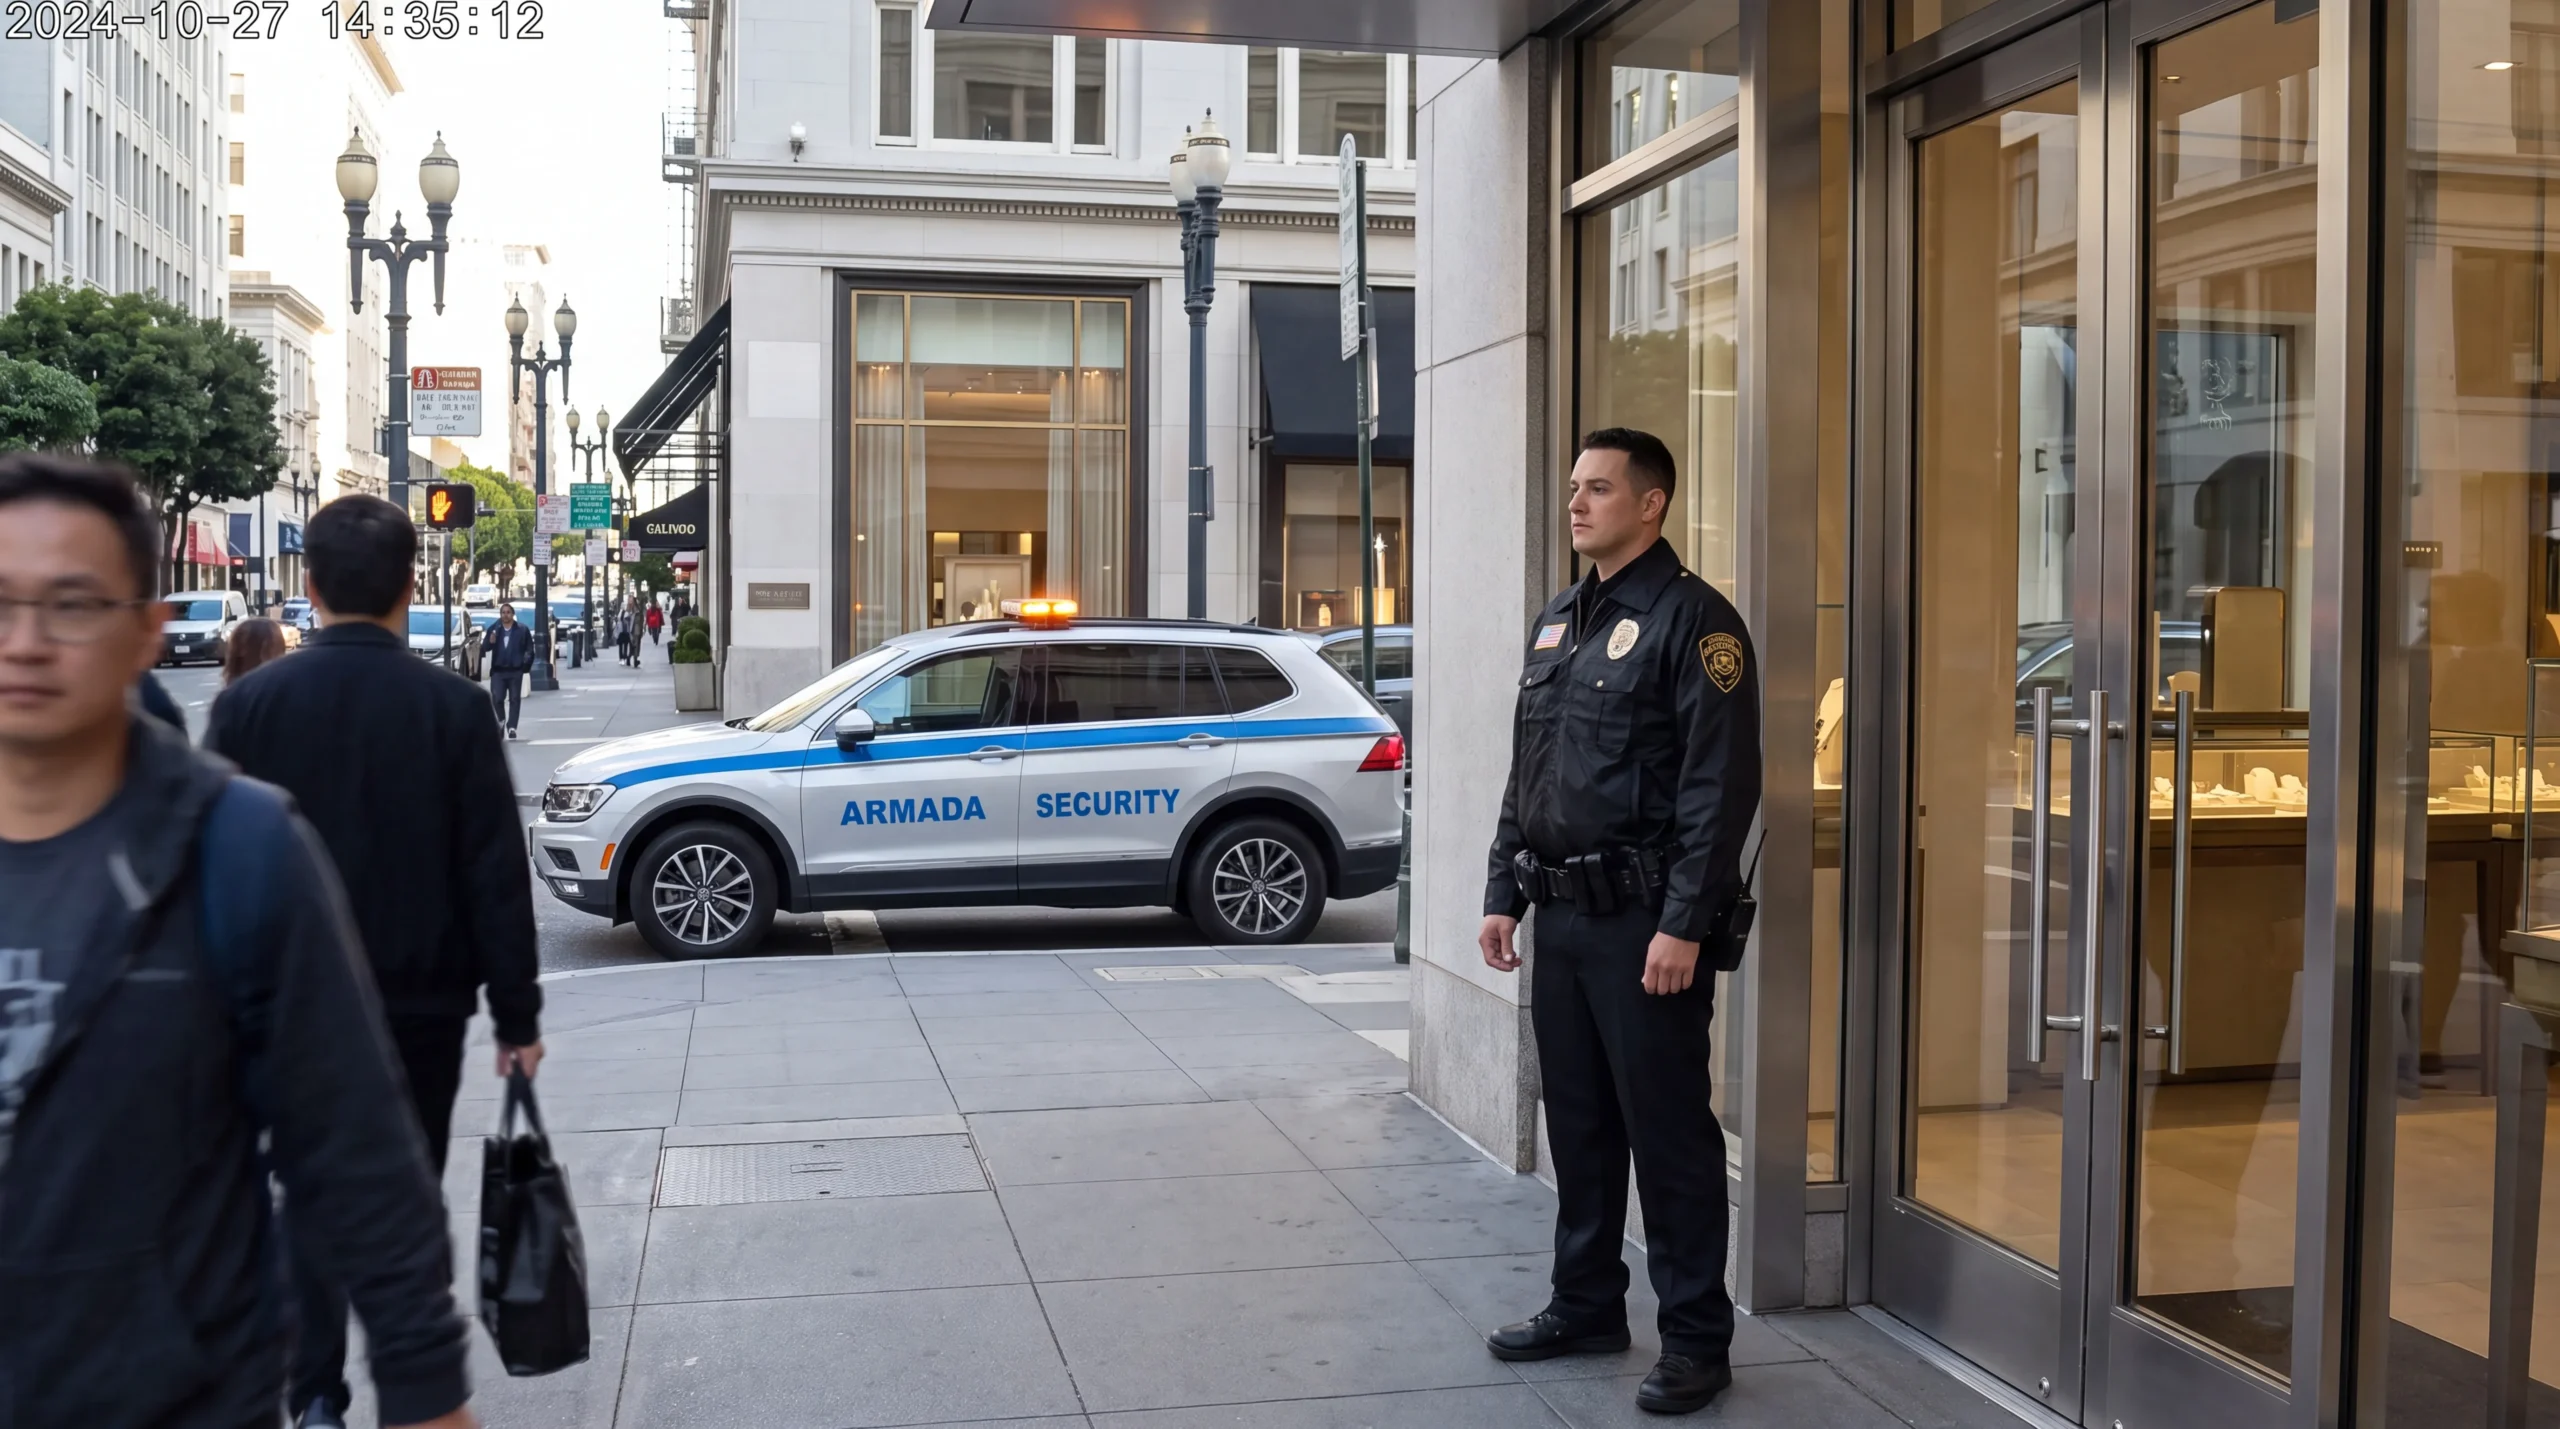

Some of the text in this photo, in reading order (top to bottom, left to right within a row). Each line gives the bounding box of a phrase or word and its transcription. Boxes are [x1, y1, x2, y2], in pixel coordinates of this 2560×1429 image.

[646, 523, 696, 535] GALIVOO
[840, 788, 1180, 826] ARMADA SECURITY
